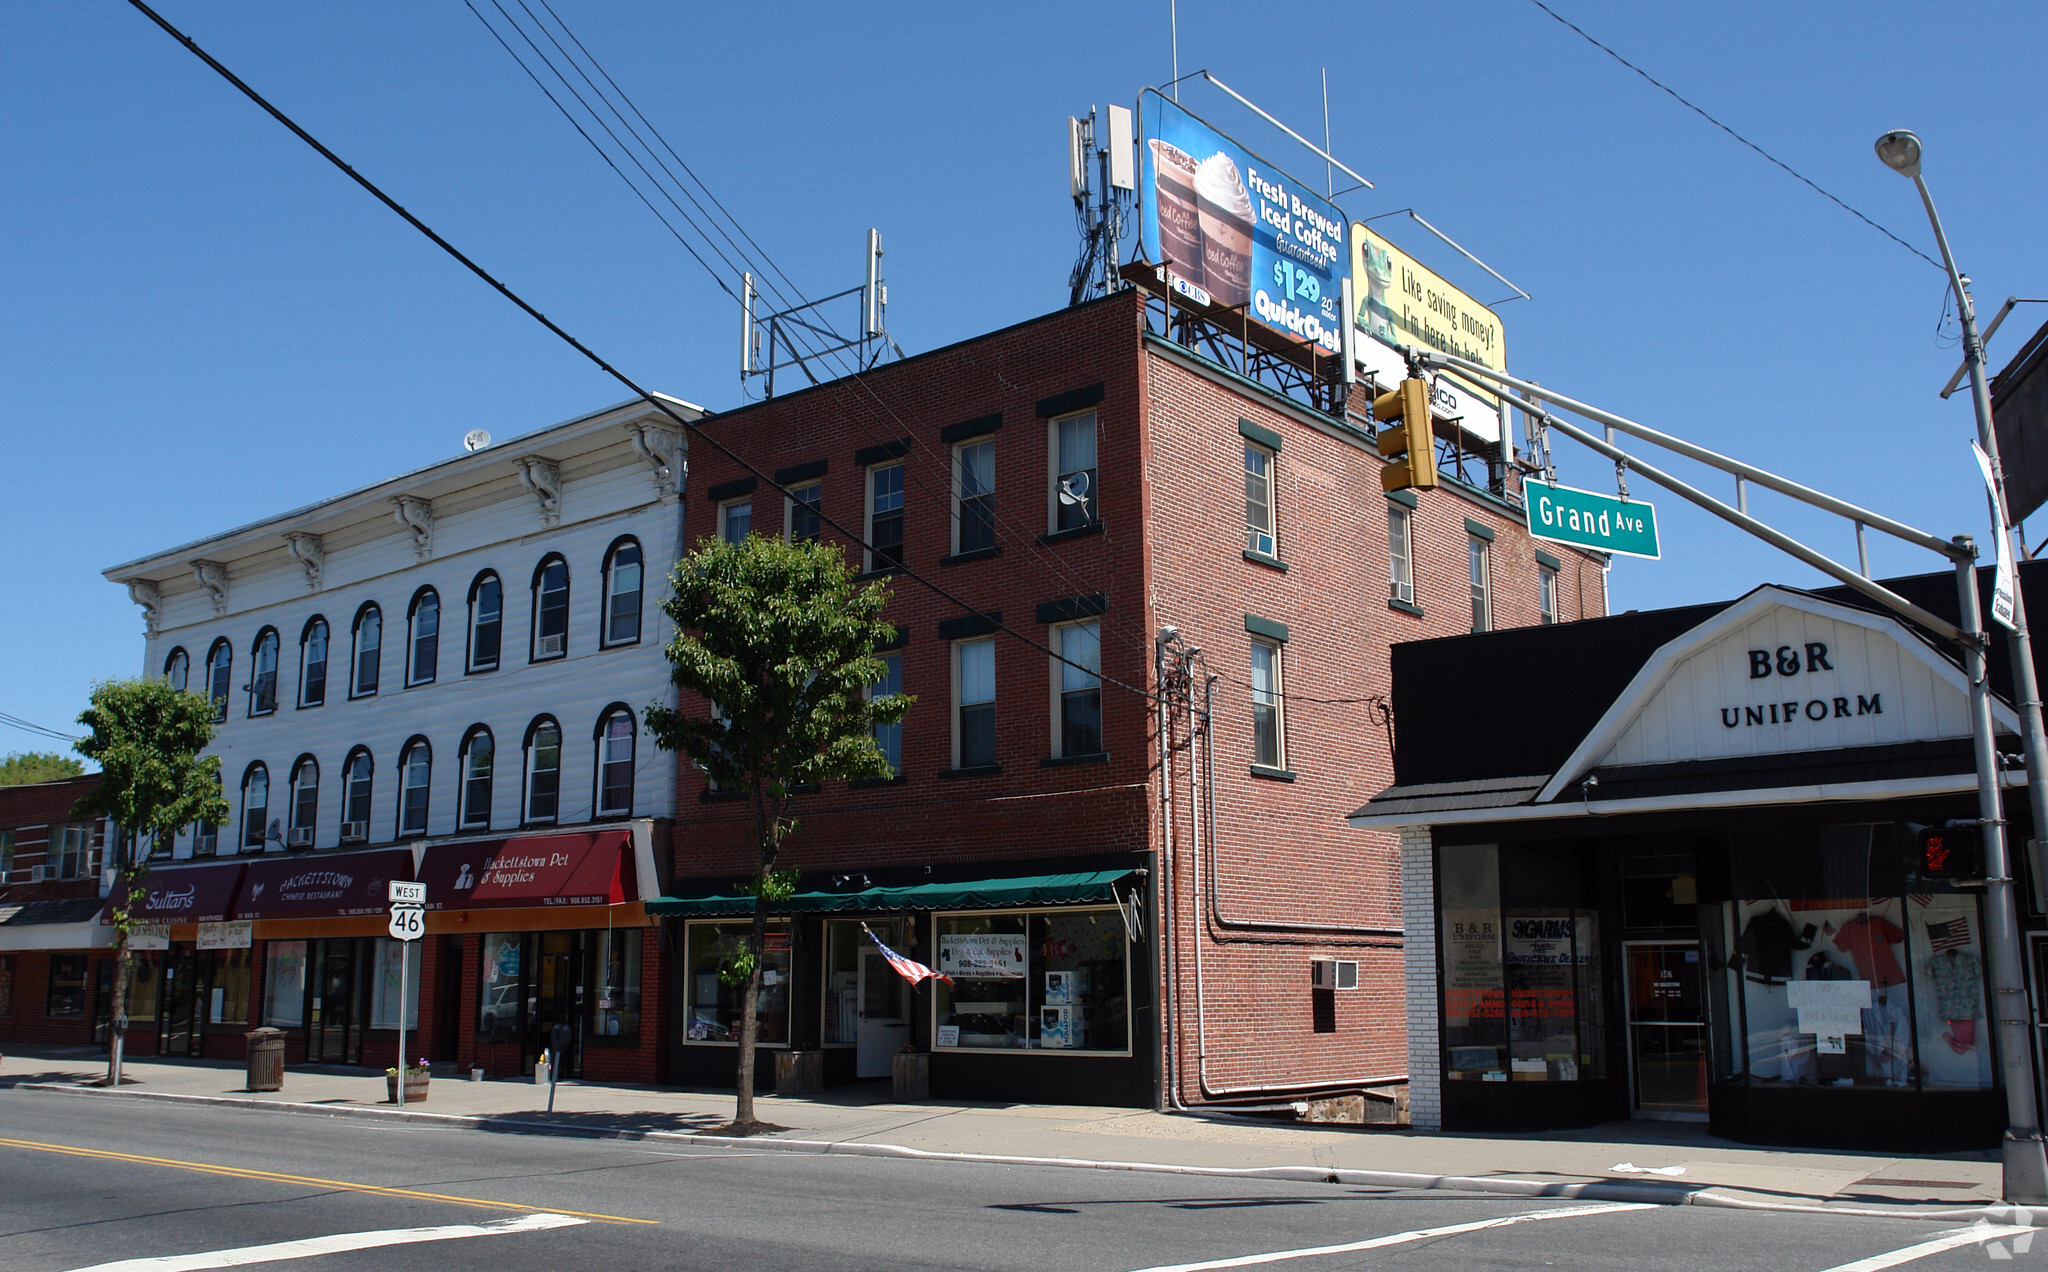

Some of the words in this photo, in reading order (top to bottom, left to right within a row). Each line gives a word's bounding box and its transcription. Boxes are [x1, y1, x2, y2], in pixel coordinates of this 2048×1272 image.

[1248, 167, 1288, 209] Fresh
[1291, 193, 1342, 243] Brewed
[1260, 199, 1291, 235] Iced
[1294, 219, 1337, 263] Coffee
[1276, 232, 1327, 271] Guaranteed!
[1188, 285, 1206, 304] CBS
[1321, 296, 1333, 312] 20
[1402, 265, 1422, 302] Like
[1427, 289, 1458, 331] saving
[1462, 310, 1495, 350] money?
[1403, 303, 1419, 337] I'm
[1424, 316, 1446, 352] here
[1450, 334, 1460, 356] to
[1539, 496, 1611, 537] Grand
[1616, 512, 1643, 533] Ave
[1748, 642, 1833, 679] B&R
[1721, 693, 1883, 729] UNIFORM
[483, 856, 546, 870] Hackettstown
[549, 852, 569, 867] Pet
[280, 872, 354, 892] HACKETTSTOWN
[492, 869, 535, 888] Supplies
[306, 890, 343, 900] RESTAURANT
[395, 886, 420, 898] WEST
[162, 916, 187, 924] CUISINE
[395, 911, 419, 932] 46
[1455, 922, 1464, 934] B
[1469, 922, 1479, 934] &
[1482, 922, 1493, 933] R
[1452, 933, 1496, 941] UNIFORM
